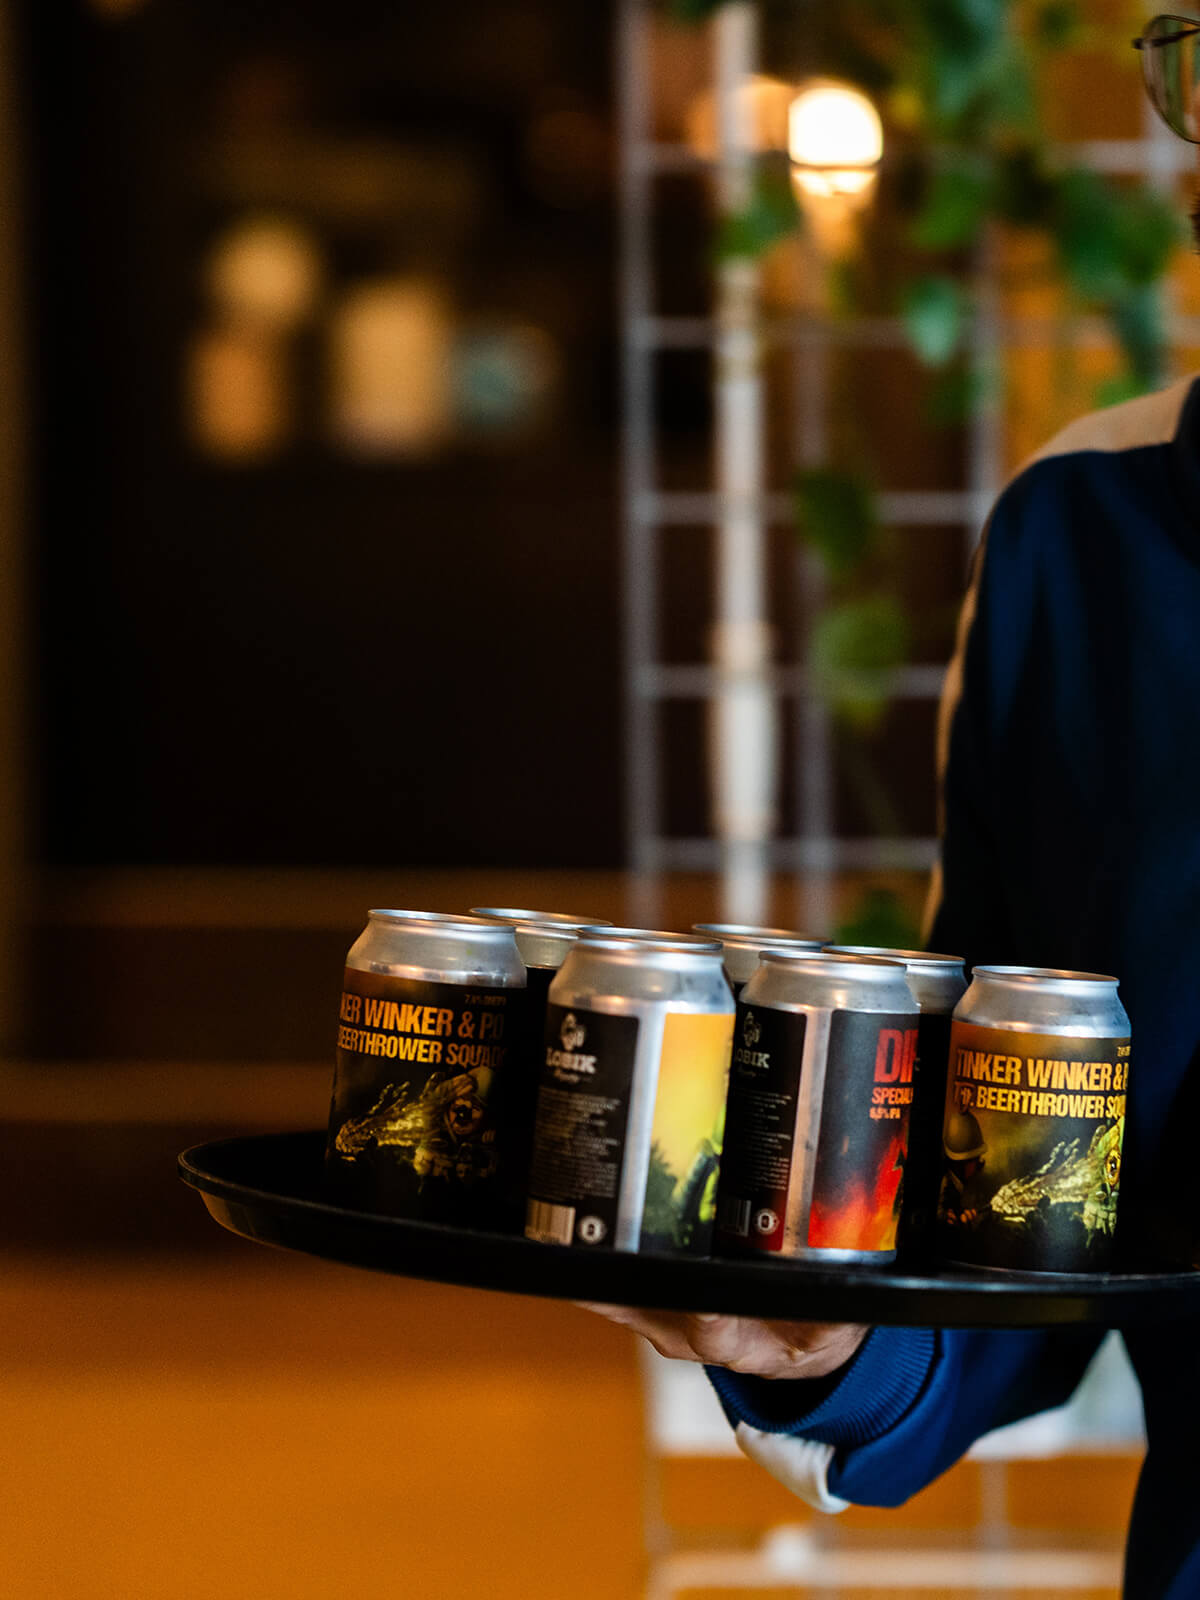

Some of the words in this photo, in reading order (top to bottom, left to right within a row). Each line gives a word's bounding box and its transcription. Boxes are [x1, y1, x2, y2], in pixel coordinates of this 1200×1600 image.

[364, 998, 454, 1037] WINKER
[457, 1010, 475, 1039] &
[734, 1047, 770, 1069] OBIK
[956, 1049, 1023, 1086] TINKER
[1027, 1058, 1113, 1091] WINKER
[1113, 1063, 1124, 1091] &
[976, 1085, 1105, 1119] BEERTHROWER
